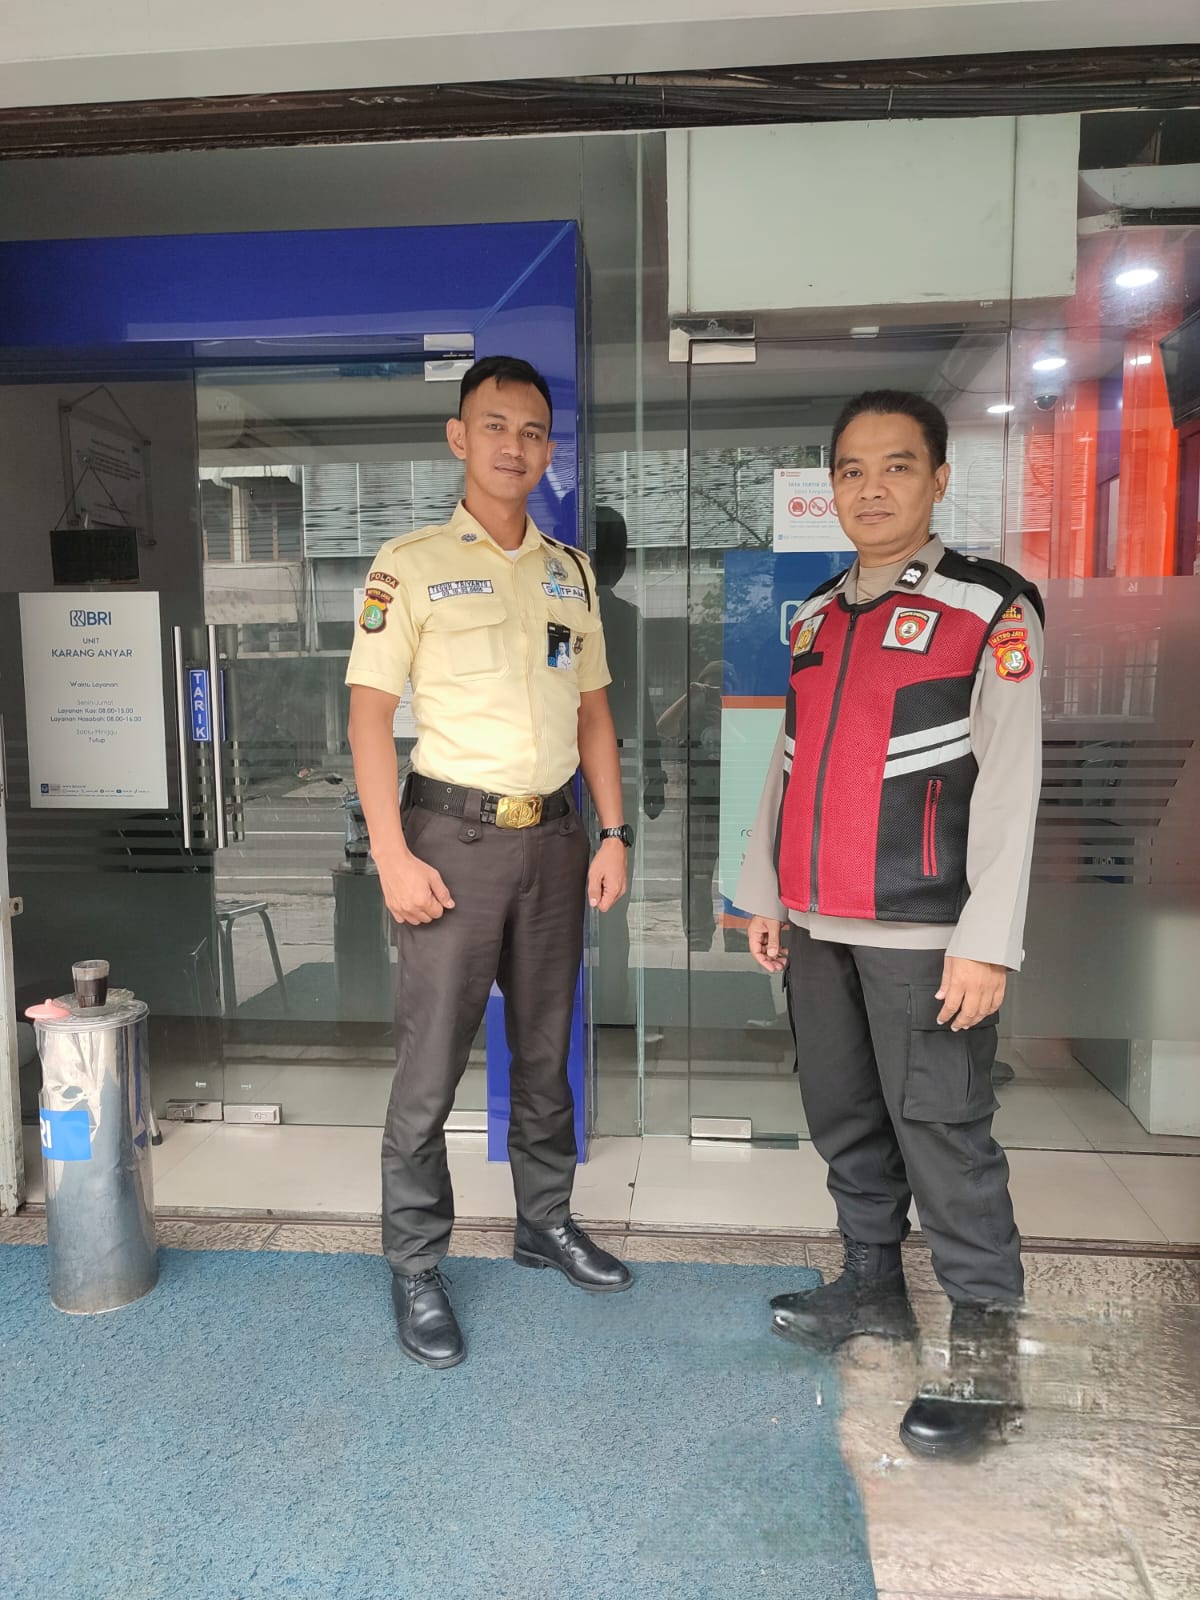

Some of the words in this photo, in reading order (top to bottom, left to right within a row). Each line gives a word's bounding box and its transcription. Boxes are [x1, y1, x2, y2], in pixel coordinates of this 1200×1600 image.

[545, 585, 584, 598] STPAM
[86, 611, 112, 626] BRI
[82, 637, 100, 645] UNIT
[51, 648, 95, 658] KARANG
[97, 648, 133, 658] ANYAR
[69, 680, 91, 688] Waktu
[192, 672, 206, 738] TARIK
[58, 707, 84, 715] Layanan
